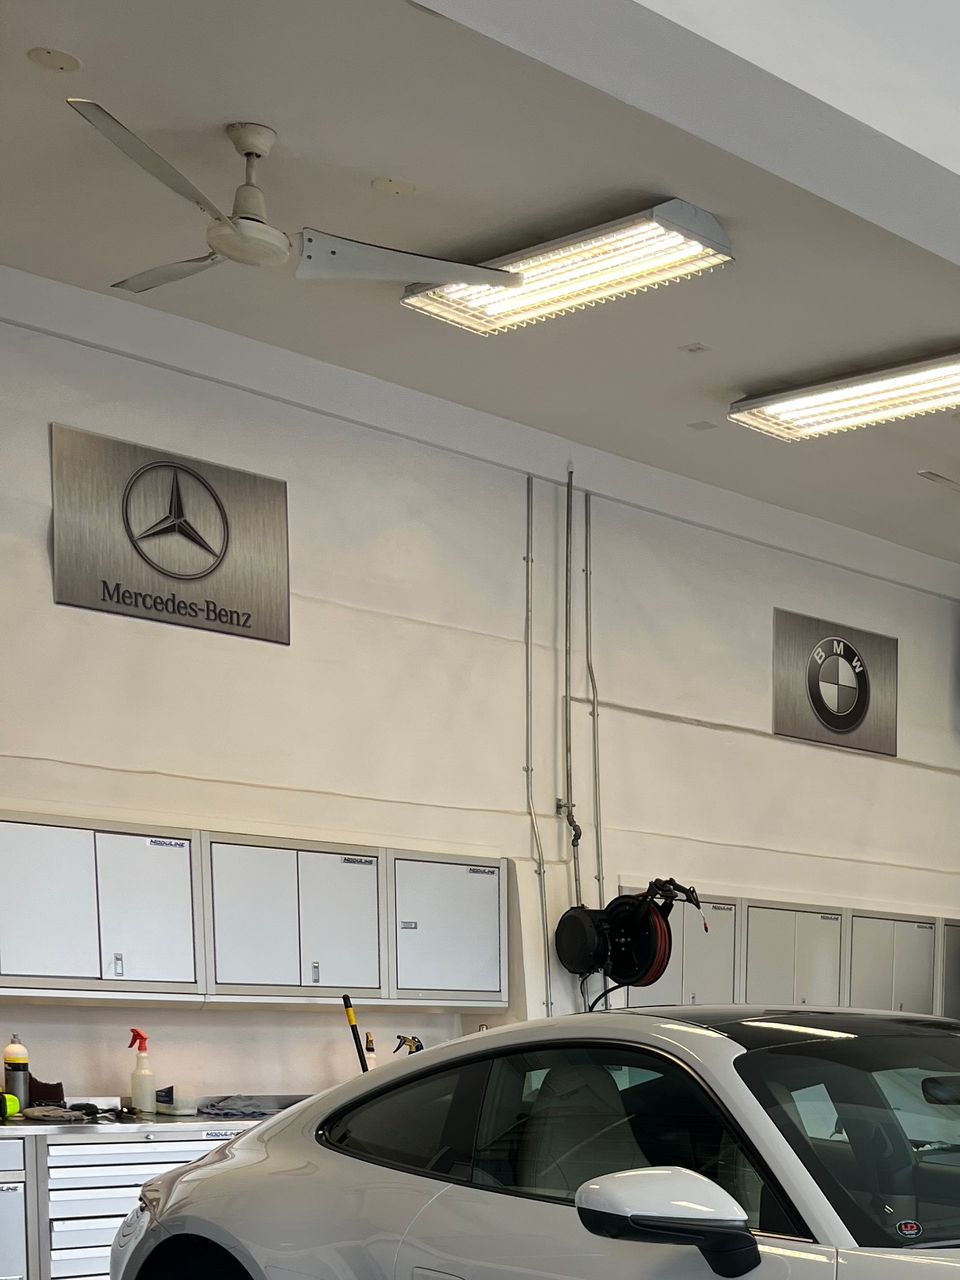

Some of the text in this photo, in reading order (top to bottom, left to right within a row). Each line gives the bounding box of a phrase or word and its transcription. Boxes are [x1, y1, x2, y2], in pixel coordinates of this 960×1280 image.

[100, 580, 252, 629] Mercedes-Benz
[813, 640, 864, 673] BMW
[150, 839, 186, 848] MODULINE
